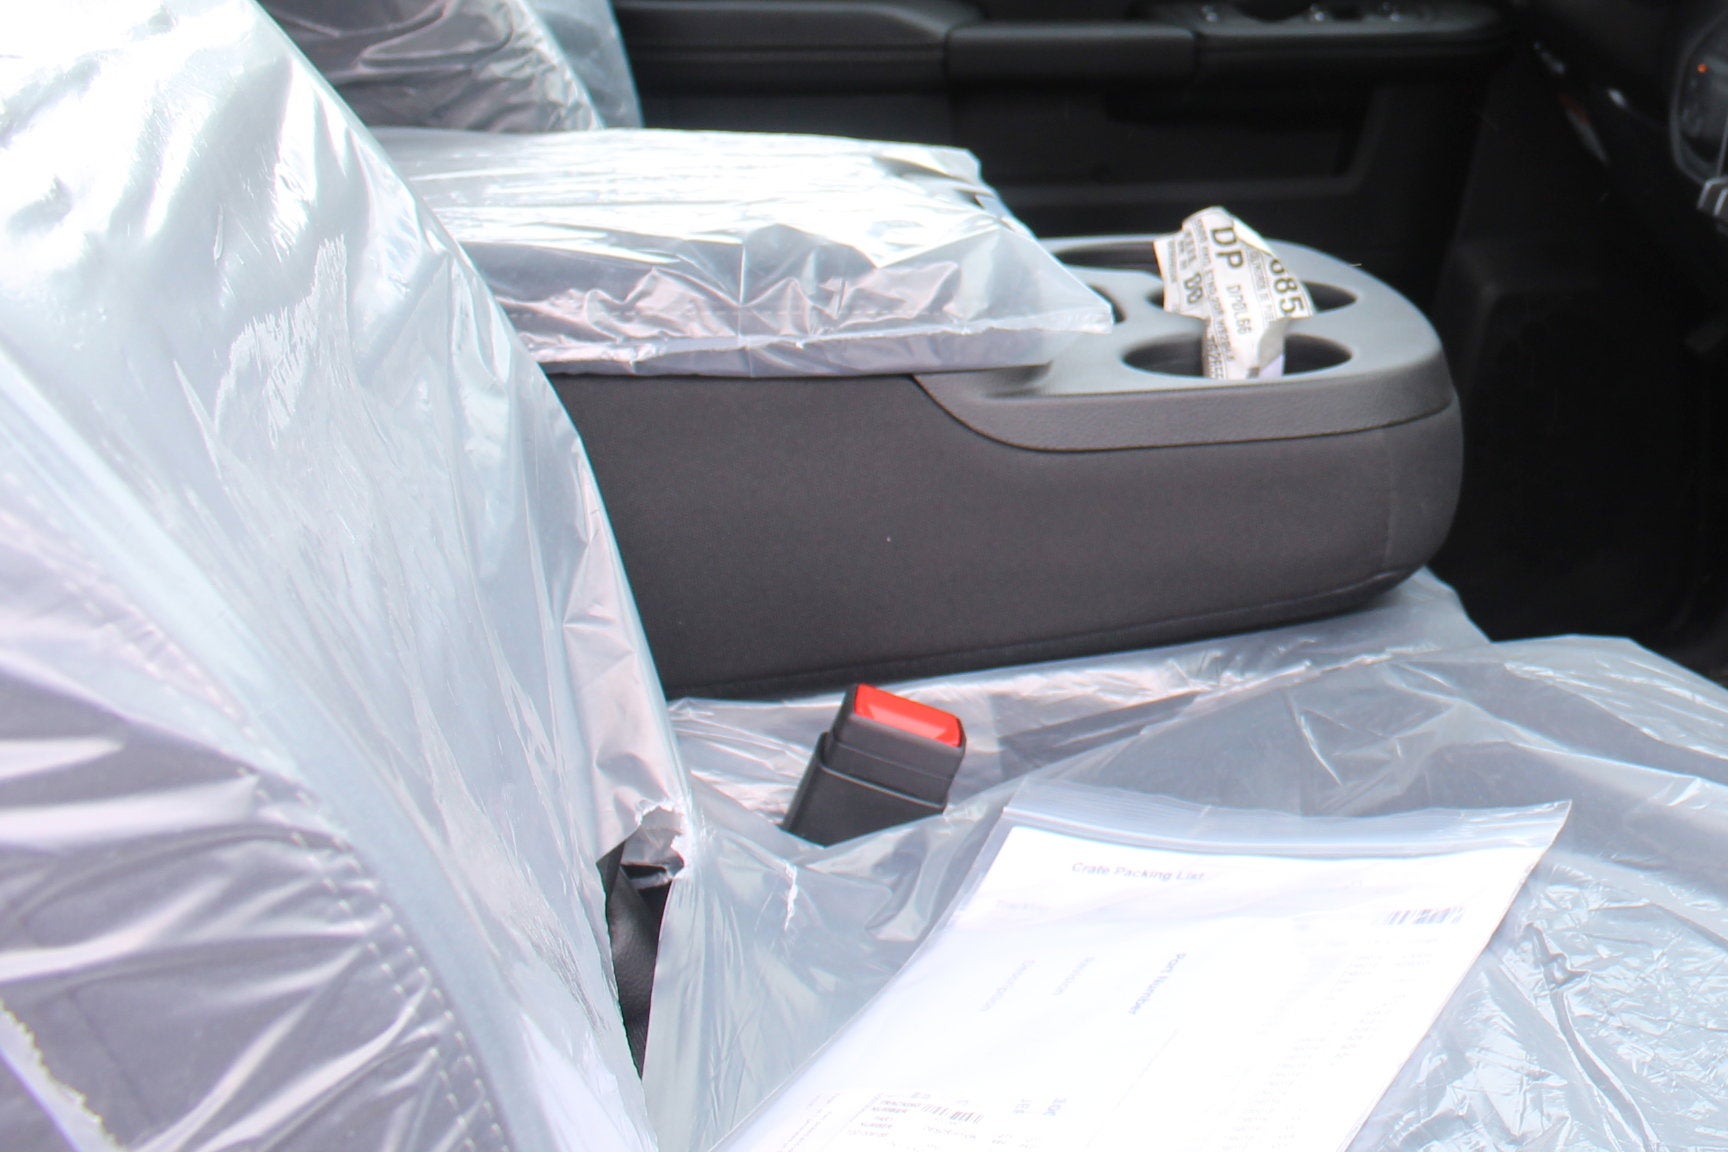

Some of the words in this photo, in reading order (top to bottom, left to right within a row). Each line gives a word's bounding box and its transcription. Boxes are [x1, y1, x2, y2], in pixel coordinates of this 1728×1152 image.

[1212, 227, 1244, 268] DP
[1072, 862, 1110, 876] Crate
[1113, 866, 1173, 882] Packing
[1175, 871, 1205, 881] List
